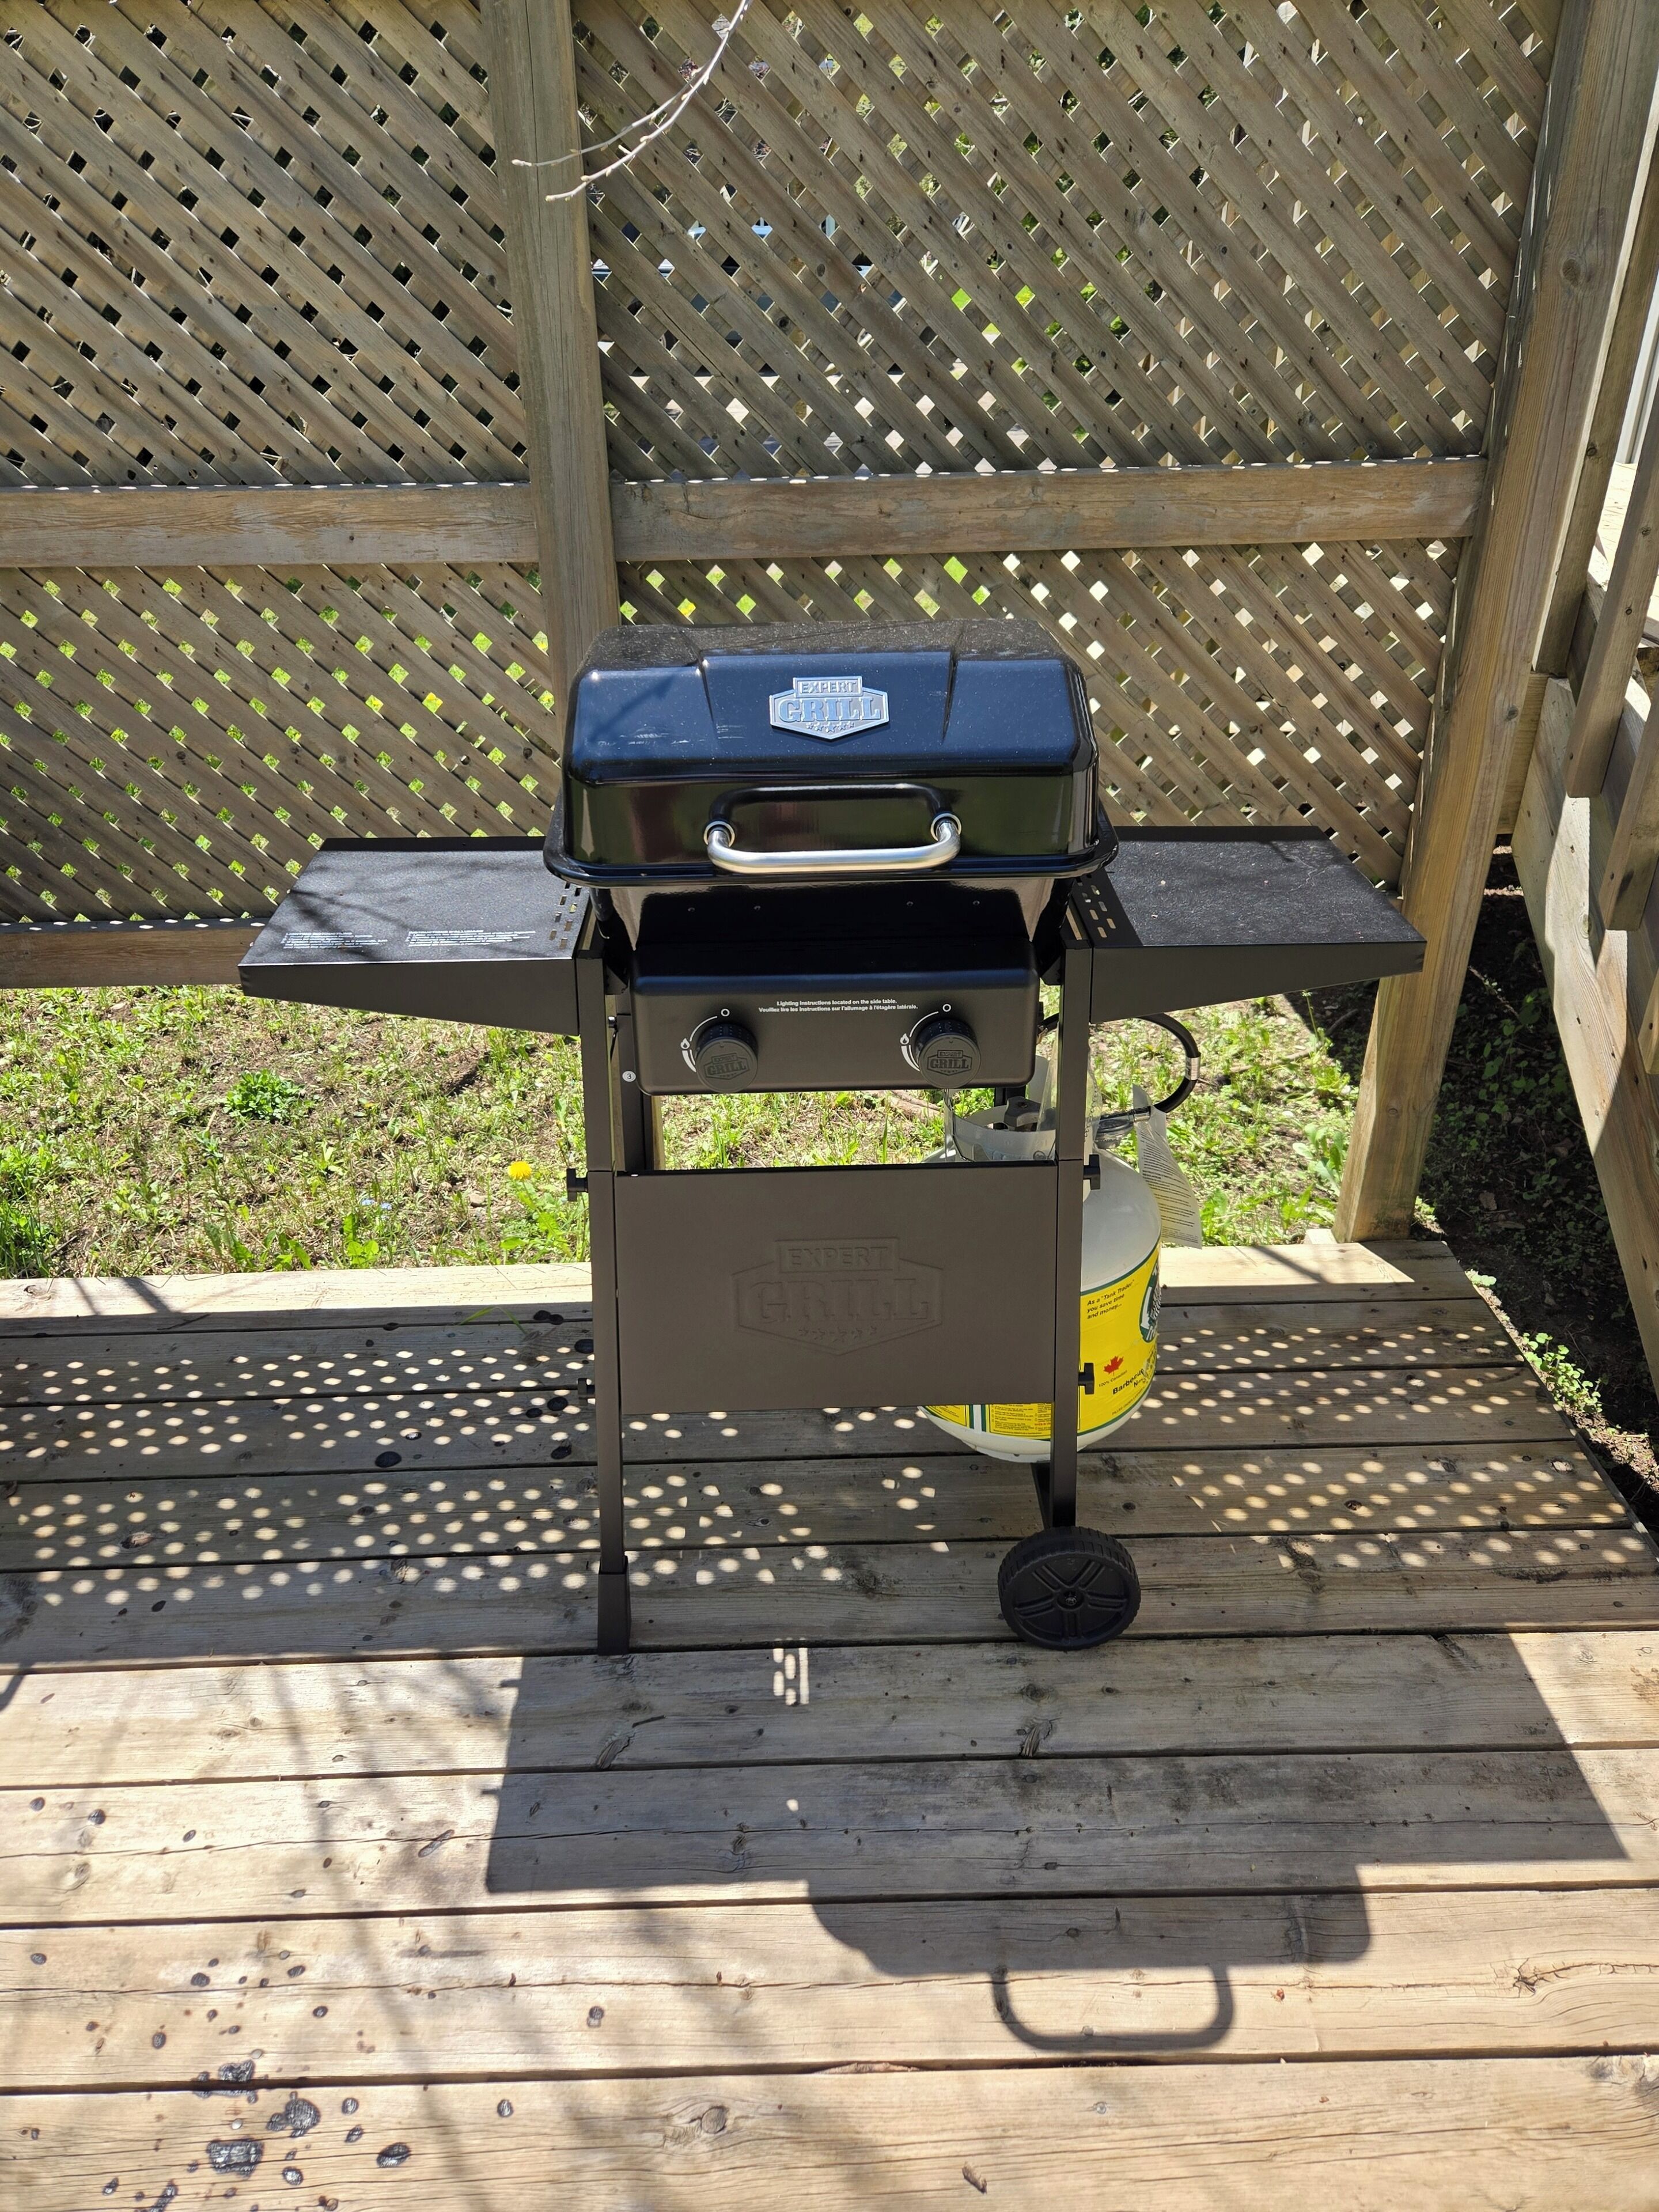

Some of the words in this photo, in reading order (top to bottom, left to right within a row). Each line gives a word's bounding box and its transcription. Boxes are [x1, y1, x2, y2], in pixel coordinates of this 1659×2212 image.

[800, 680, 857, 694] EXPERT
[778, 696, 881, 722] GRILL
[707, 1061, 747, 1075] GRILL
[930, 1059, 969, 1069] GRILL
[788, 1246, 888, 1267] EXPERT
[751, 1278, 929, 1324] GRILL
[1113, 1294, 1125, 1302] time
